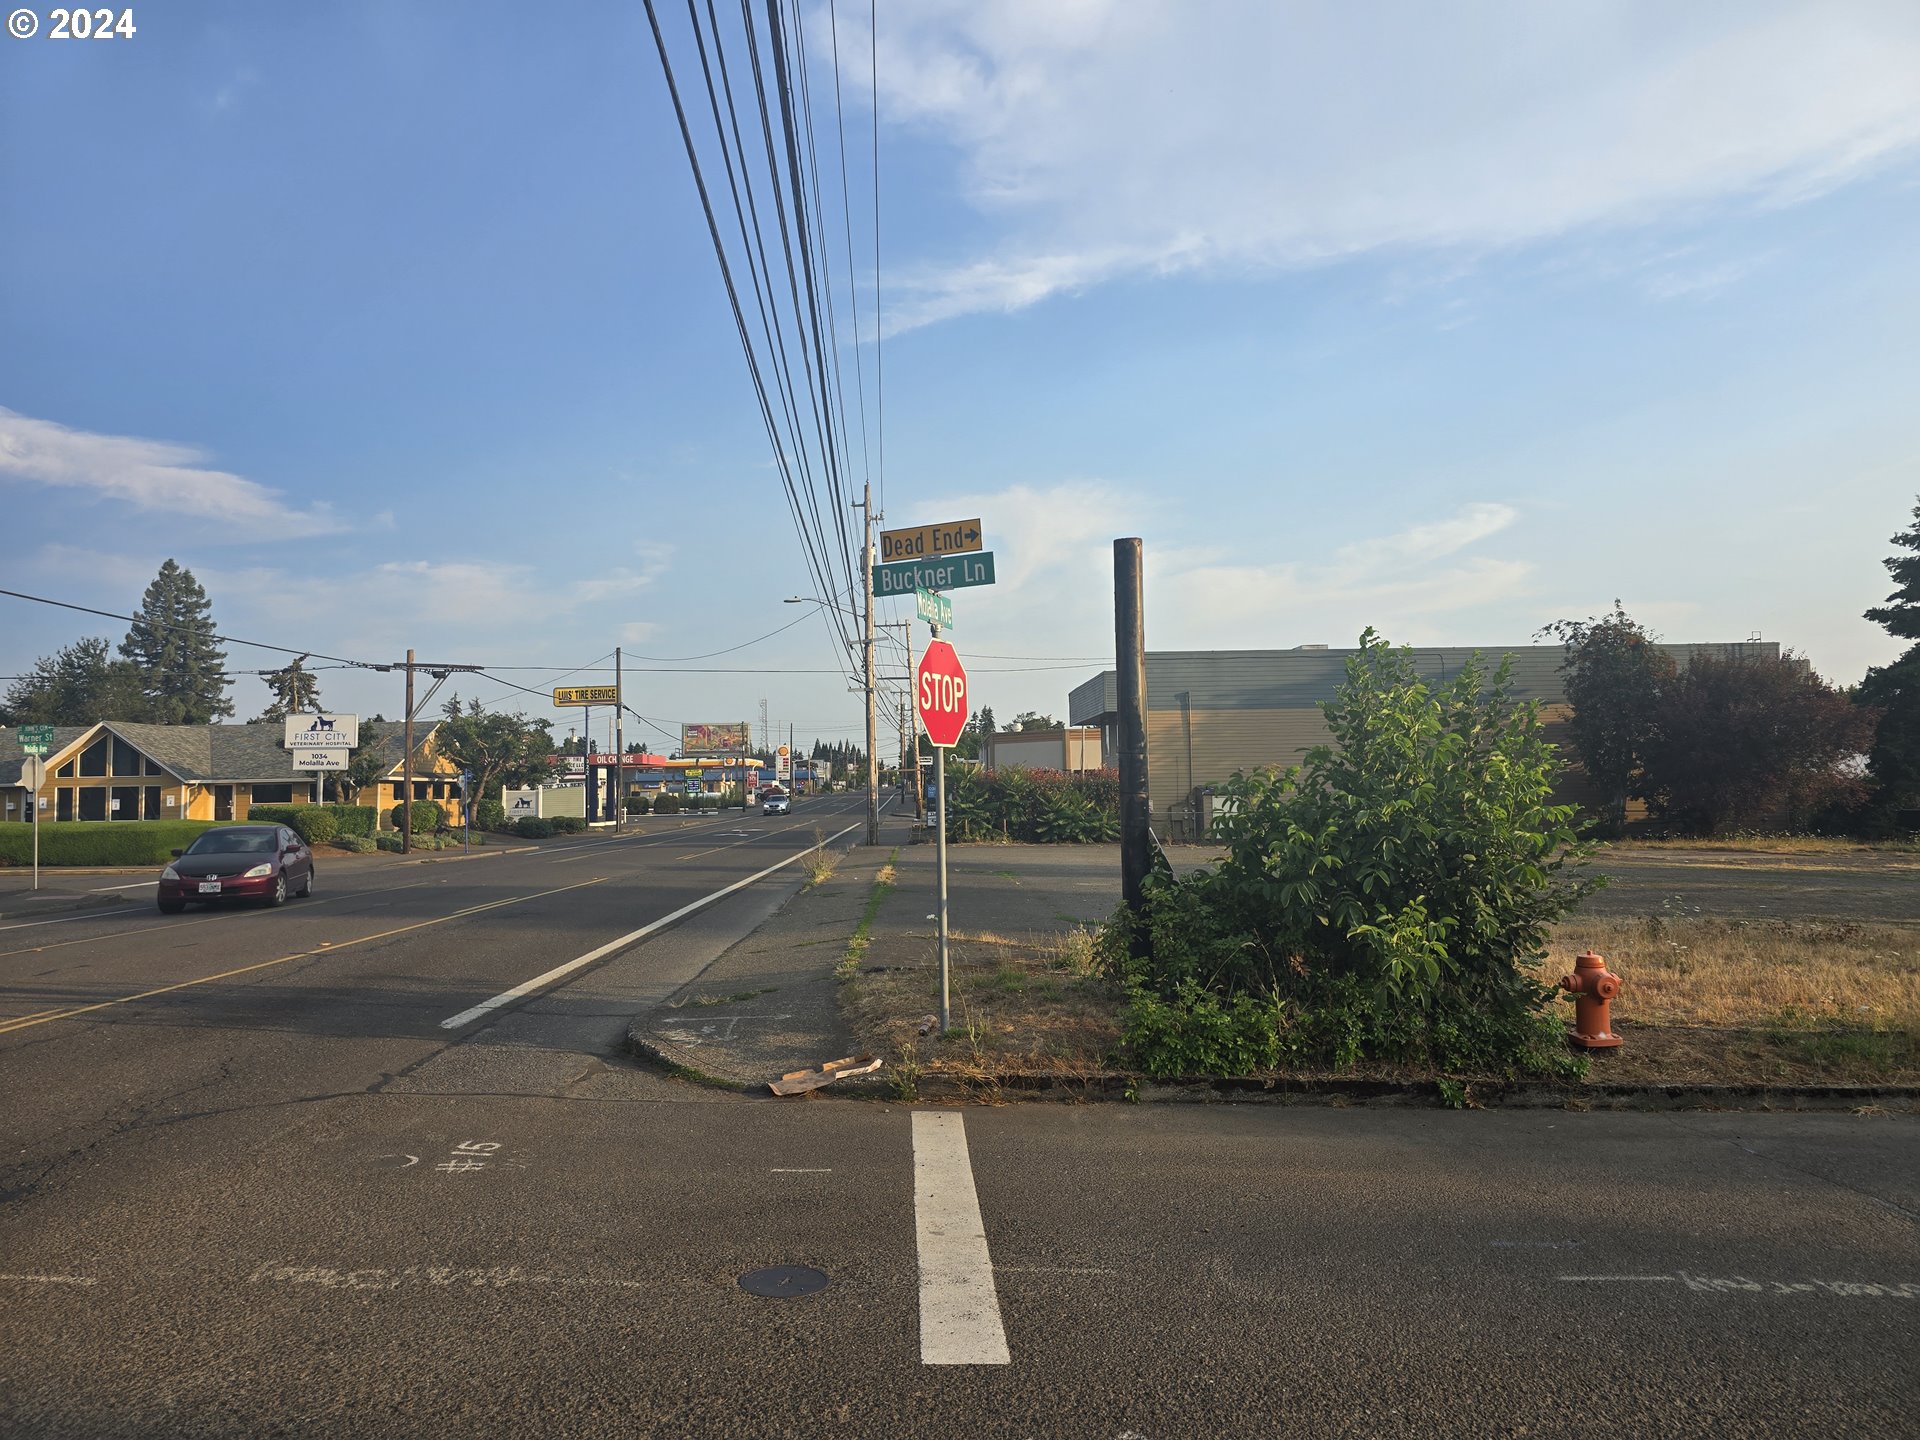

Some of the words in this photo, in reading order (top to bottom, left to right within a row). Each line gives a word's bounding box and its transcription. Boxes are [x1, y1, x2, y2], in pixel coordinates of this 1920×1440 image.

[882, 531, 924, 558] Dead
[932, 526, 964, 551] End
[881, 566, 954, 592] Buckner
[963, 559, 986, 582] Ln
[917, 592, 939, 620] Molalla
[940, 600, 952, 625] Ave
[575, 689, 589, 699] TIRE
[589, 689, 616, 699] SERVICE
[921, 671, 965, 713] STOP
[18, 734, 43, 743] Warner
[45, 733, 53, 742] St
[294, 732, 320, 741] FIRST
[325, 732, 347, 741] CITY
[596, 755, 608, 764] OIL
[608, 755, 634, 764] CHNGE
